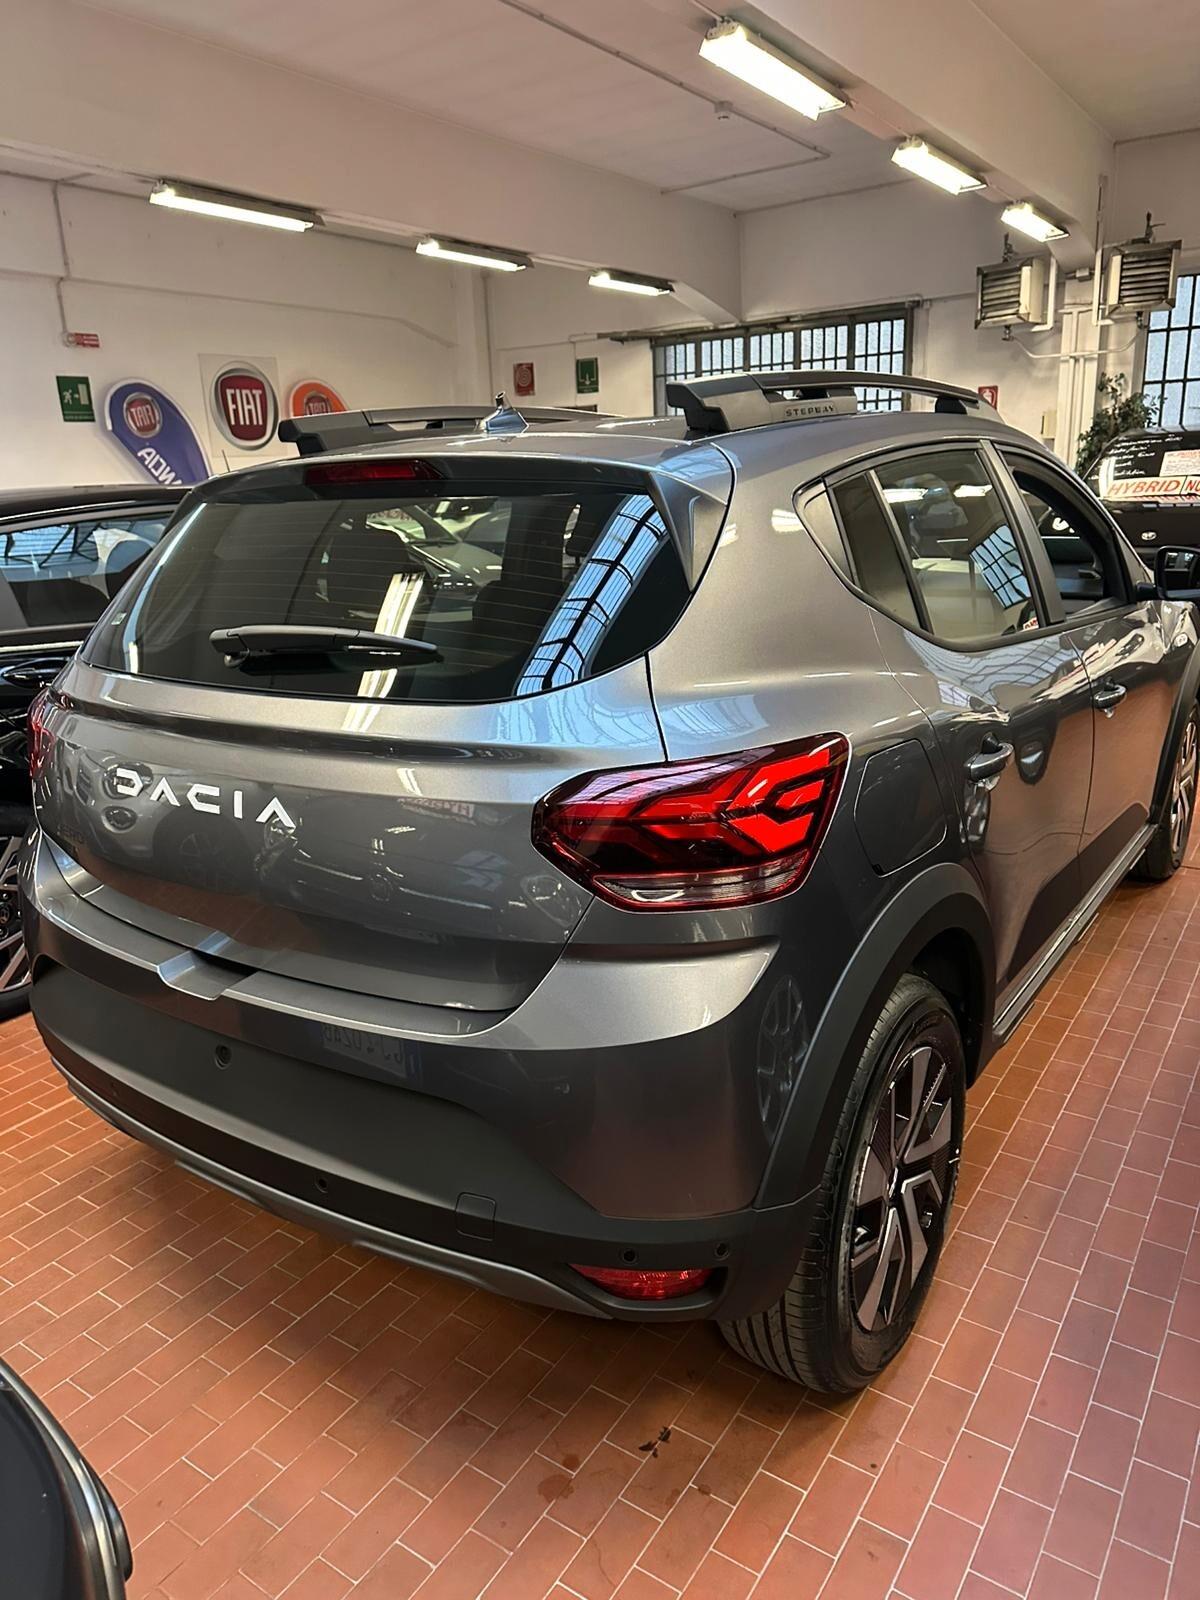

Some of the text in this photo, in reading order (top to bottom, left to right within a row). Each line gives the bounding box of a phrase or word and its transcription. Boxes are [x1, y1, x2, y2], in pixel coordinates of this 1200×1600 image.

[226, 388, 263, 426] FIAT
[786, 405, 835, 417] STEPWAY
[1108, 480, 1181, 496] HYBRID
[115, 768, 297, 831] DACIA
